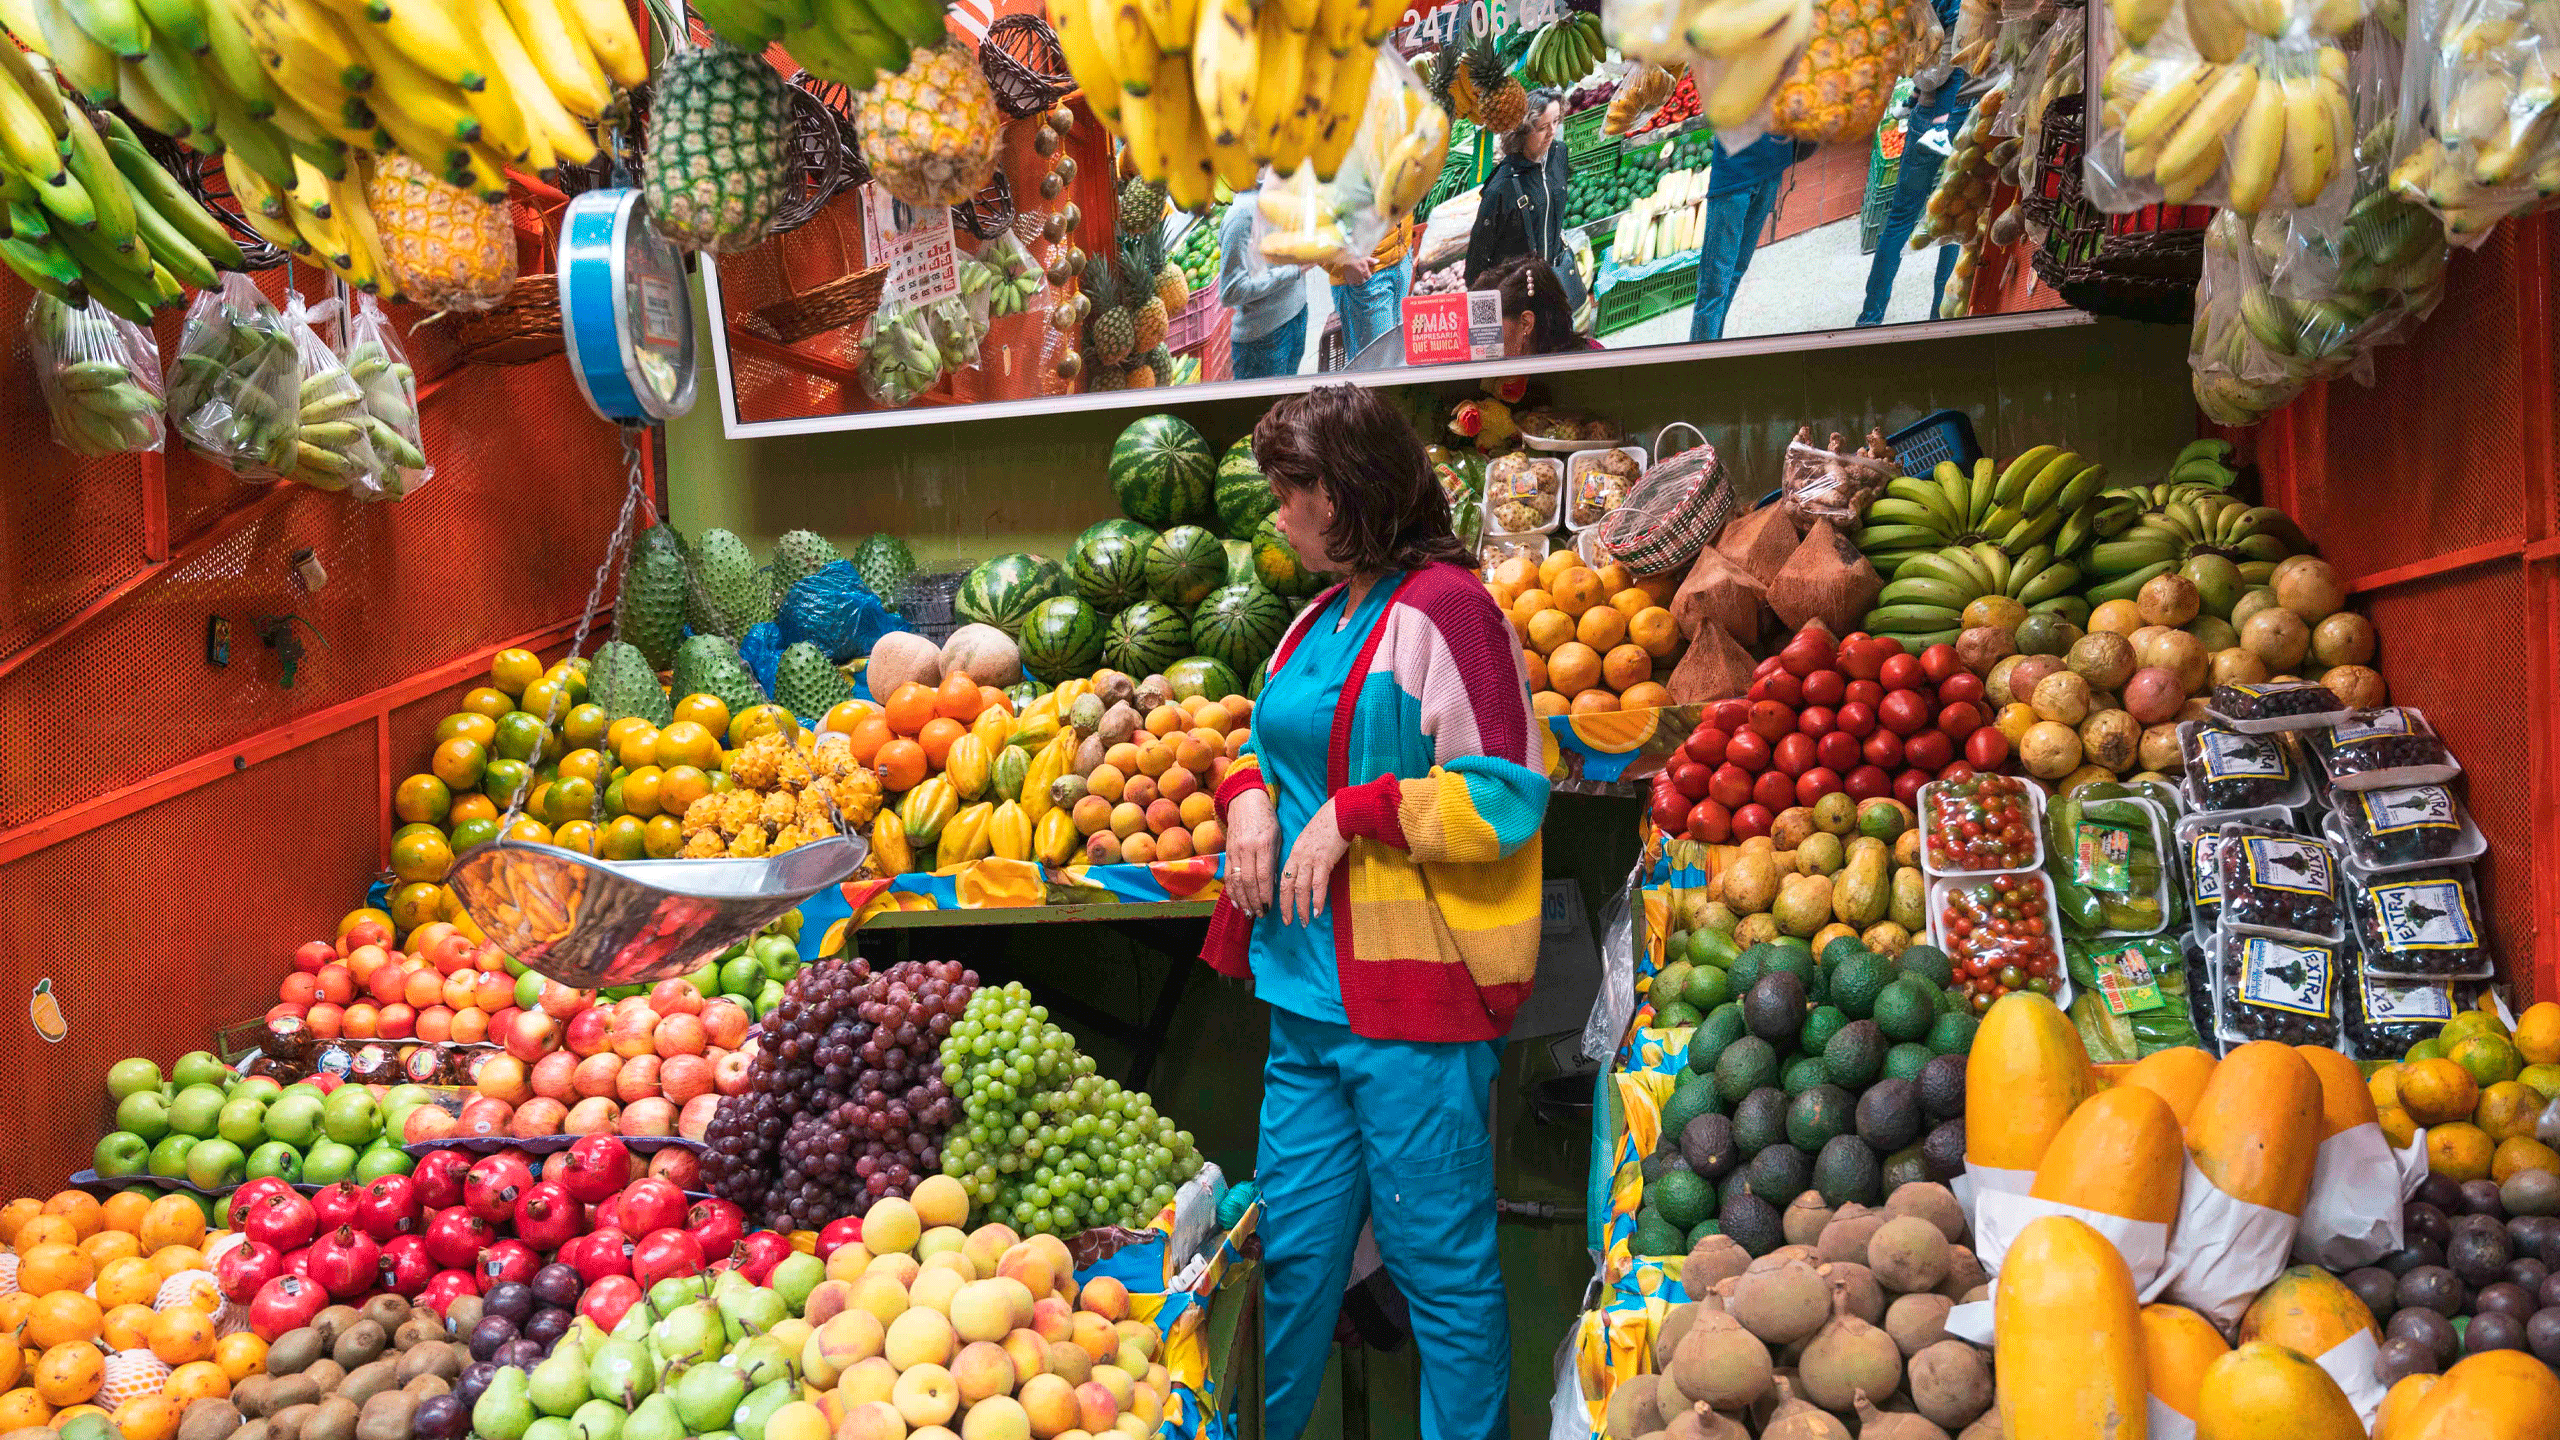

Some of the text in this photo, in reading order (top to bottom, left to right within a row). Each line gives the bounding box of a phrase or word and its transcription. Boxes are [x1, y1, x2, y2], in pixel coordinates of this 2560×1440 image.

[1403, 4, 1459, 47] 247
[1471, 0, 1509, 38] 06
[1412, 305, 1457, 334] #MÁS
[1412, 331, 1458, 342] EMPRESARIA
[1412, 339, 1459, 354] QUE NUNCA
[2418, 786, 2446, 817] EXTRA
[2201, 843, 2218, 893] EXRA
[2301, 845, 2325, 887] EXTRA
[2388, 891, 2416, 941] EXTRA
[2299, 953, 2322, 1005] EXTRA
[2370, 979, 2395, 1013] EXT
